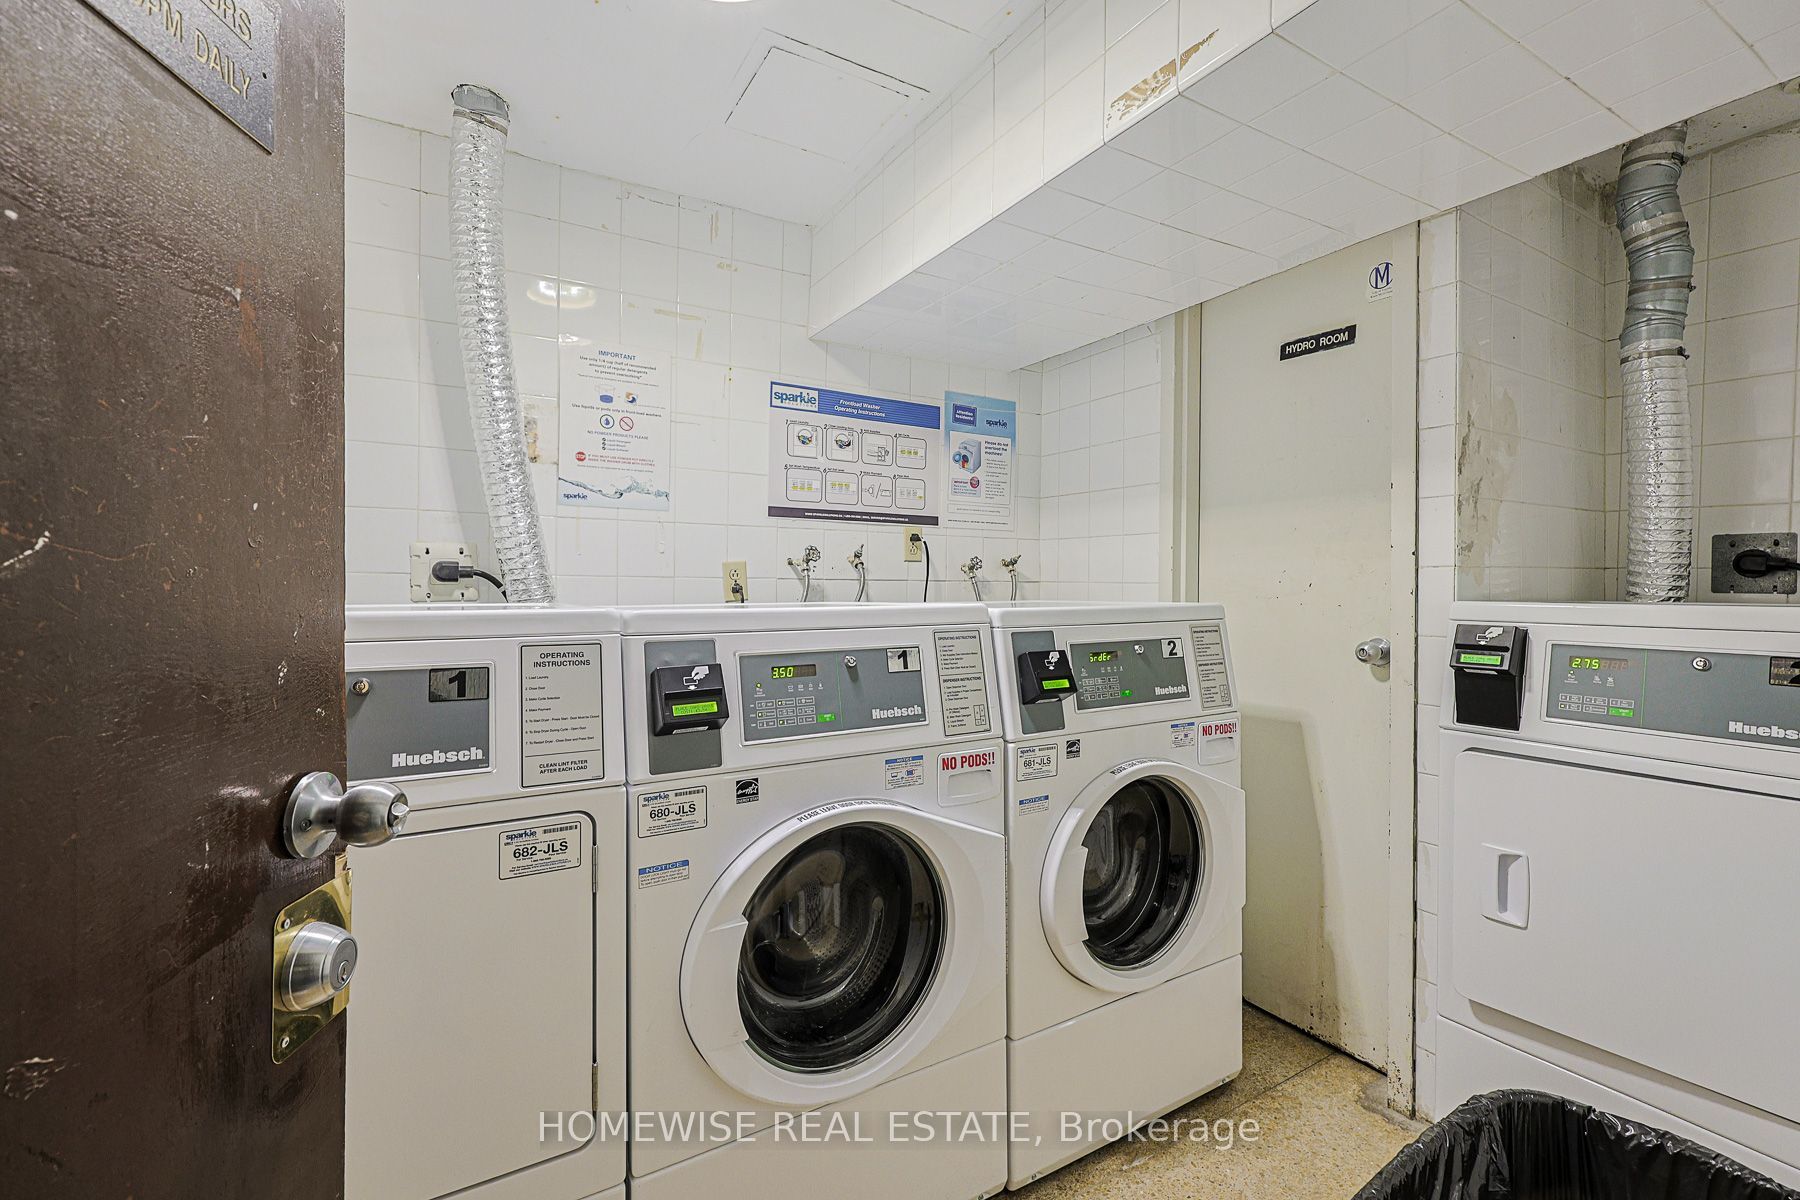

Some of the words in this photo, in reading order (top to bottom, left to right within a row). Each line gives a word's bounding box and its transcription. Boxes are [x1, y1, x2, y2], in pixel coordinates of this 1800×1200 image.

[195, 28, 252, 100] DAILY
[1286, 340, 1316, 354] HYDRO
[1320, 332, 1348, 346] ROOM
[598, 350, 637, 361] IMPORTANT
[839, 400, 863, 408] Frontload
[834, 405, 857, 415] Operating
[858, 408, 886, 417] Instructions
[1167, 640, 1178, 656] 2
[533, 660, 590, 668] INSTRUCTIONS
[898, 650, 908, 669] 1
[1572, 658, 1600, 669] 2.75
[772, 667, 793, 679] 3.50
[449, 671, 466, 698] 1
[1155, 684, 1187, 695] Huebsch
[872, 705, 922, 720] Huebsch
[1202, 726, 1212, 736] NO
[1215, 723, 1237, 735] PODS!!
[1729, 721, 1800, 740] Huebs
[392, 747, 482, 768] Huebsch
[942, 757, 957, 771] NO
[961, 752, 995, 768] PODS!!
[1024, 757, 1051, 768] 681-JLS
[539, 762, 558, 770] CLEAN
[650, 804, 696, 819] 680-JLS
[797, 810, 821, 822] PLEASE
[513, 841, 568, 859] 682-JLS
[646, 862, 683, 873] NOTICE
